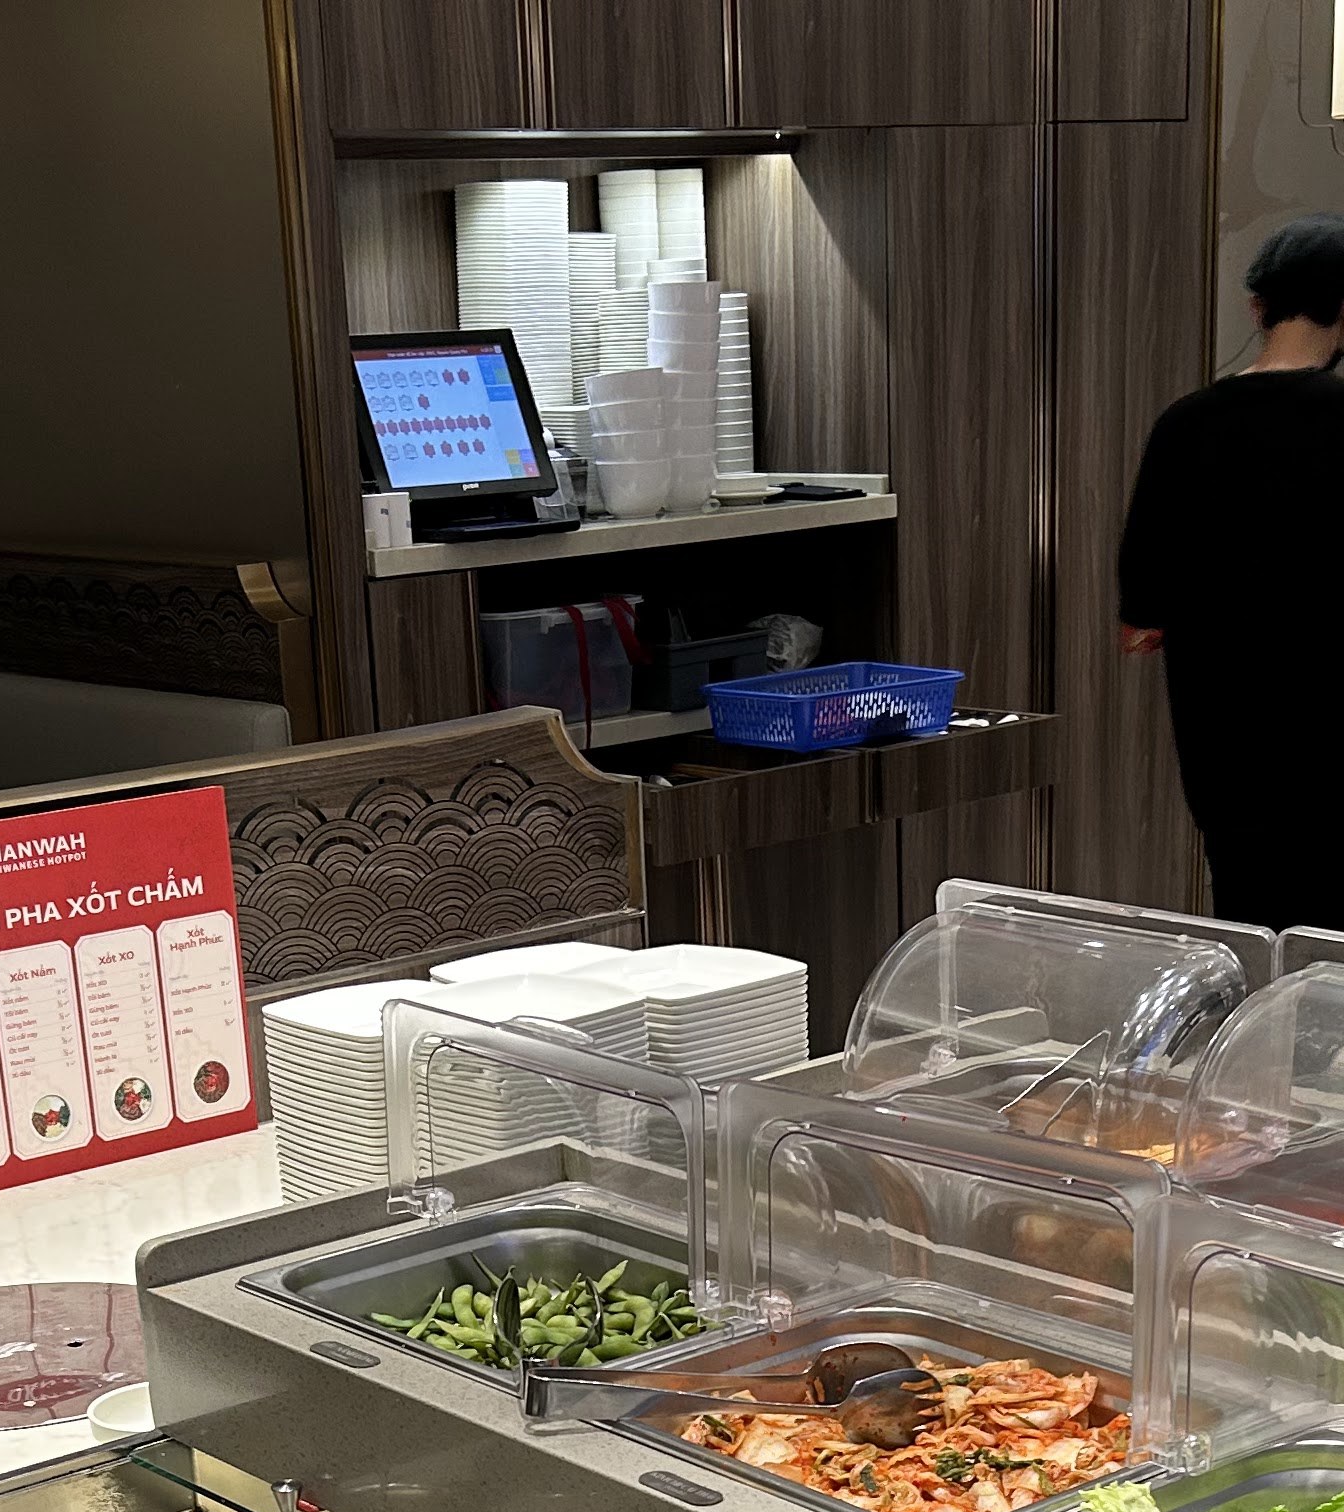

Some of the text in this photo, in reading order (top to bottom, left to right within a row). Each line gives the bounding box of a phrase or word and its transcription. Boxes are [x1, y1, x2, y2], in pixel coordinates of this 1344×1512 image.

[47, 851, 87, 865] HOTPOT
[5, 901, 62, 929] PHA
[66, 881, 122, 918] XỐT
[127, 867, 204, 907] CHẤM
[118, 950, 135, 962] XO
